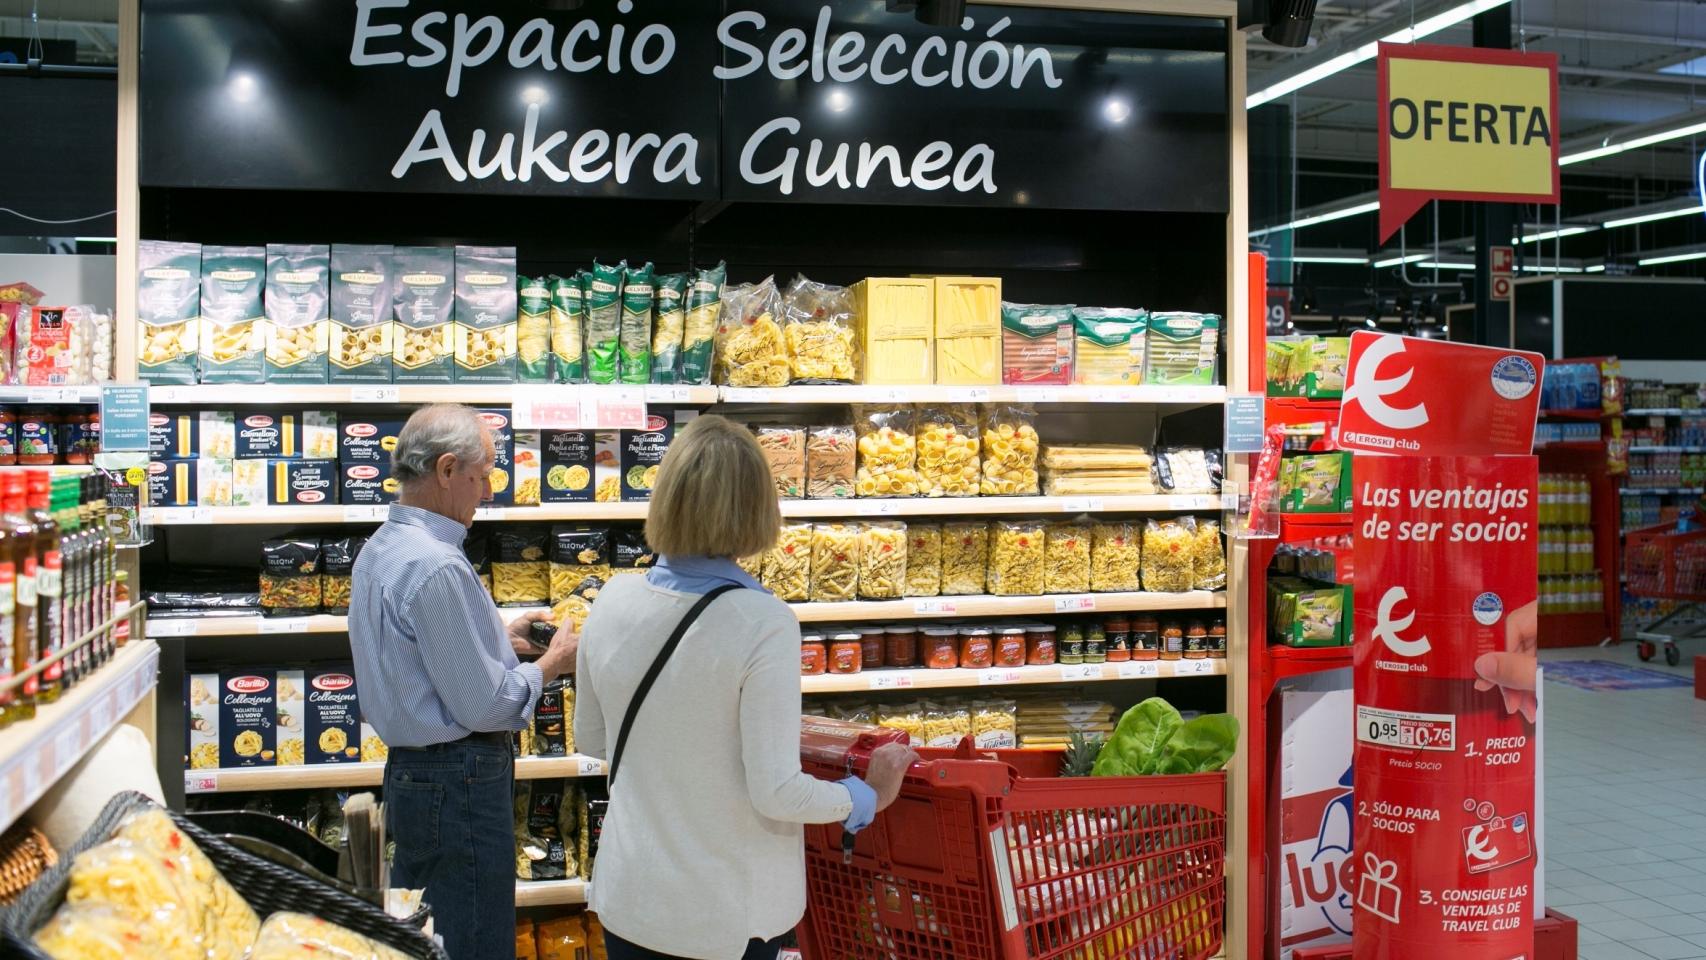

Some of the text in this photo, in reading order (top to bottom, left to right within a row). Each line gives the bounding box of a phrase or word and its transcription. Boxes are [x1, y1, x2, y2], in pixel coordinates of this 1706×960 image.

[350, 0, 1062, 97] Espacio Selección
[1389, 98, 1551, 147] OFERTA
[391, 103, 997, 194] Aukera Gunea
[343, 437, 380, 447] Collezione
[1359, 435, 1421, 450] EROSKI club
[345, 479, 381, 490] Collezione
[1362, 482, 1529, 515] Las ventajas
[1362, 513, 1529, 542] de ser socio:
[1409, 664, 1428, 672] club
[237, 679, 266, 688] Barilla
[321, 677, 350, 686] Barilla
[224, 694, 273, 705] Collezione
[309, 691, 356, 704] Collezione
[1369, 721, 1398, 739] 0,95
[1415, 727, 1451, 746] 0,76
[1464, 735, 1526, 758] 1. PRECIO
[1389, 758, 1442, 771] Precio SOCIO
[1485, 751, 1521, 766] SOCIO
[1358, 800, 1441, 821] 2. SÓLO PARA
[1372, 817, 1416, 834] SOCIOS
[1419, 885, 1528, 905] 3. CONSIGUE LAS
[1442, 901, 1522, 917] VENTAJAS DE
[1442, 916, 1521, 932] TRAVEL CLUB
